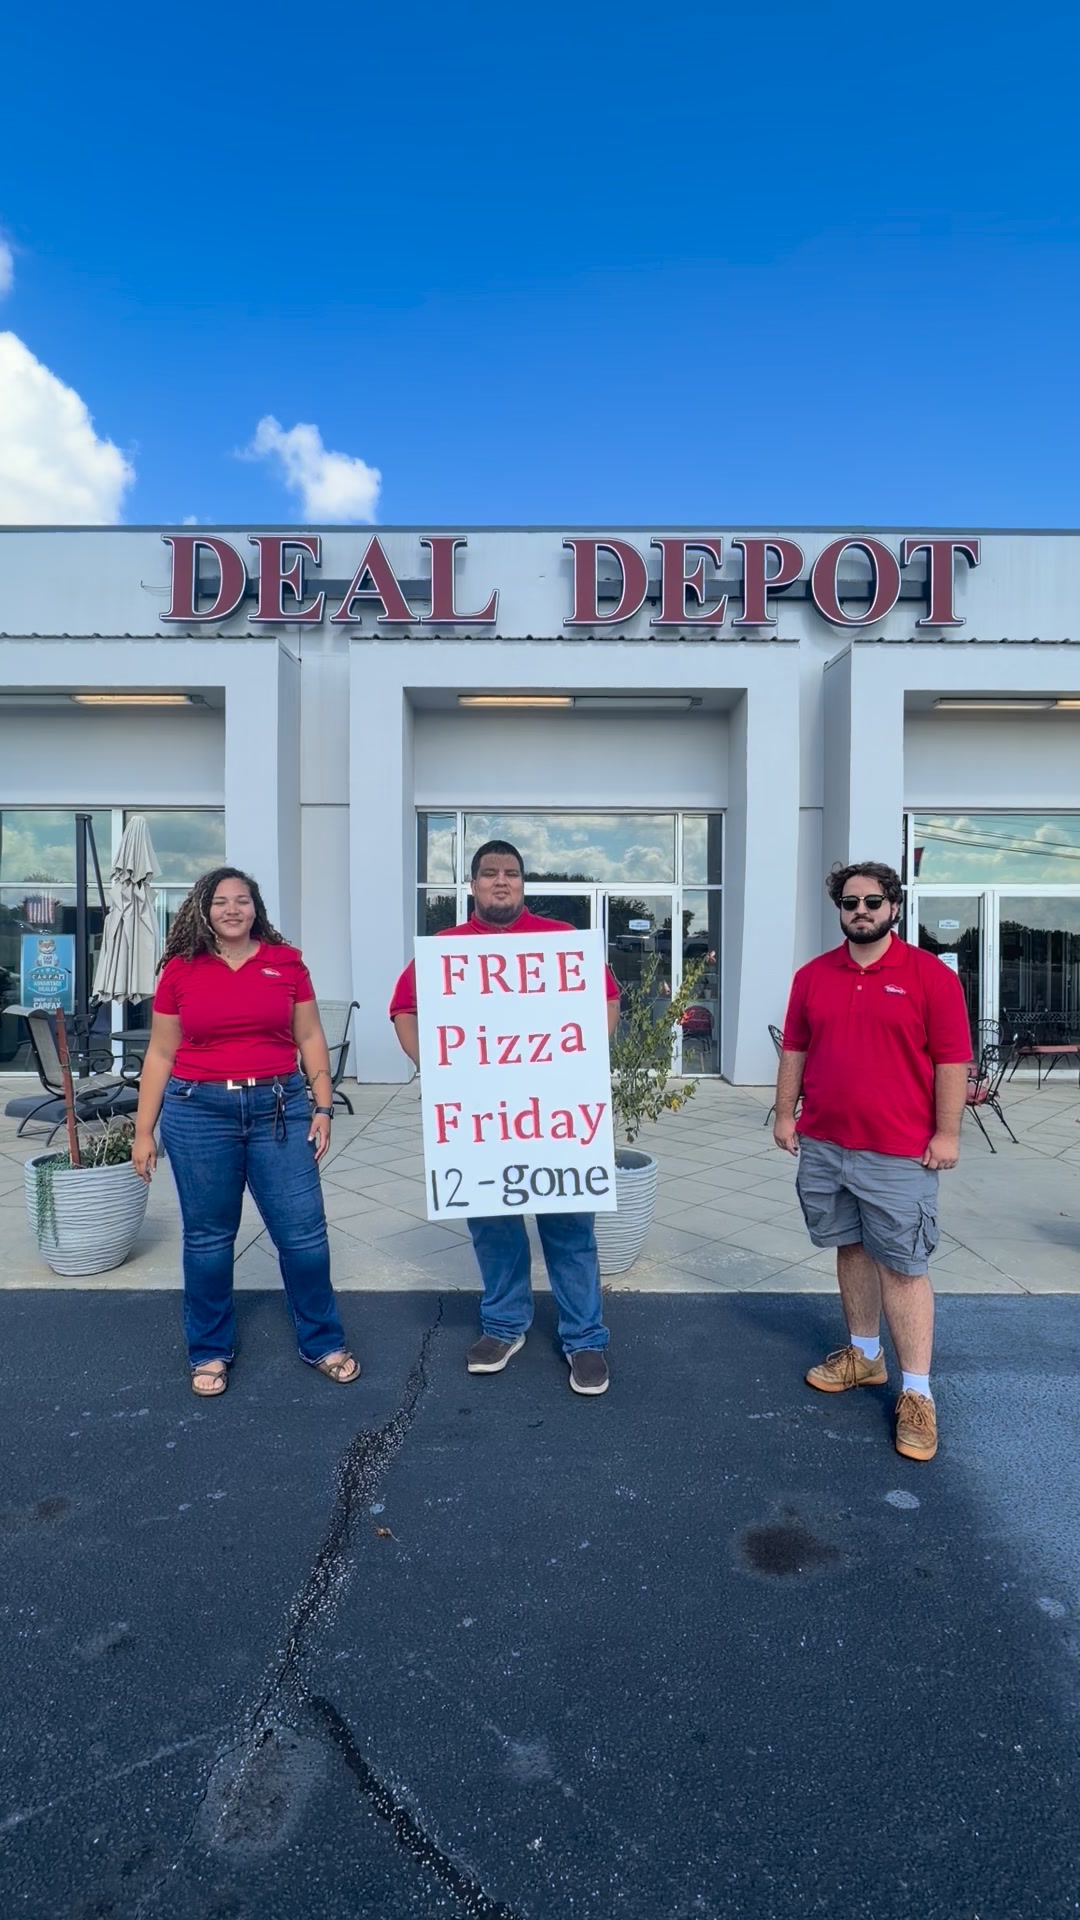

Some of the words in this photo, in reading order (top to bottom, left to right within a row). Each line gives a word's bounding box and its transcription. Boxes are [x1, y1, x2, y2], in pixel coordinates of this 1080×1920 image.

[159, 534, 500, 624] DEAL
[561, 534, 982, 627] DEPOT
[440, 950, 587, 997] FREE
[436, 1021, 587, 1067] Pizza
[434, 1096, 608, 1147] Friday
